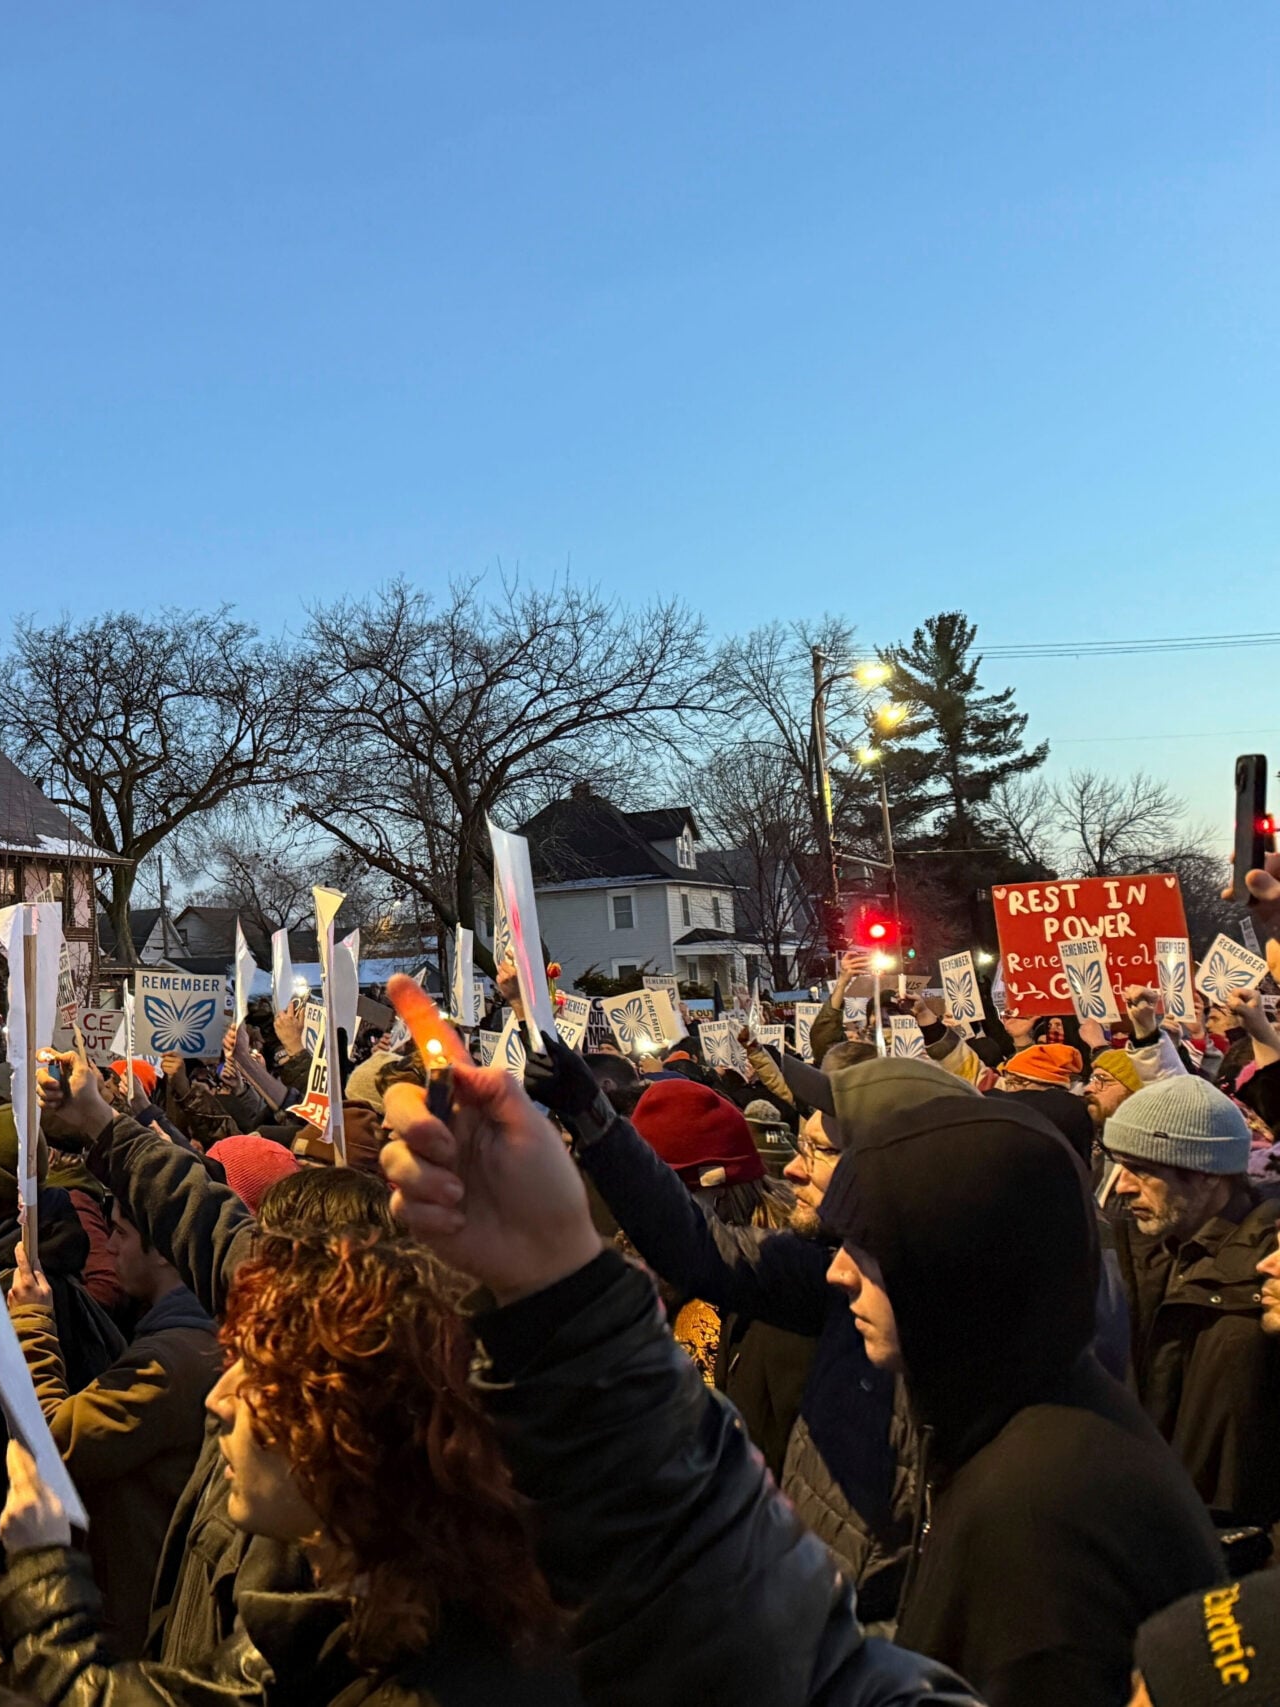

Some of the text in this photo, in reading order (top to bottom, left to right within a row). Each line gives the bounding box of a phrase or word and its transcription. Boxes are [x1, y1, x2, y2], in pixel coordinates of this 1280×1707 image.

[1008, 881, 1147, 916] REST IN
[1043, 912, 1137, 942] POWER
[1061, 940, 1099, 957] REMEMBER
[1217, 938, 1266, 972] REMEMBER
[1007, 943, 1158, 974] Rene icol
[142, 975, 220, 992] REMEMBER
[589, 1011, 604, 1025] OUT
[702, 1022, 728, 1033] REMEMB
[760, 1026, 782, 1035] EMBER
[72, 1034, 113, 1050] OUT
